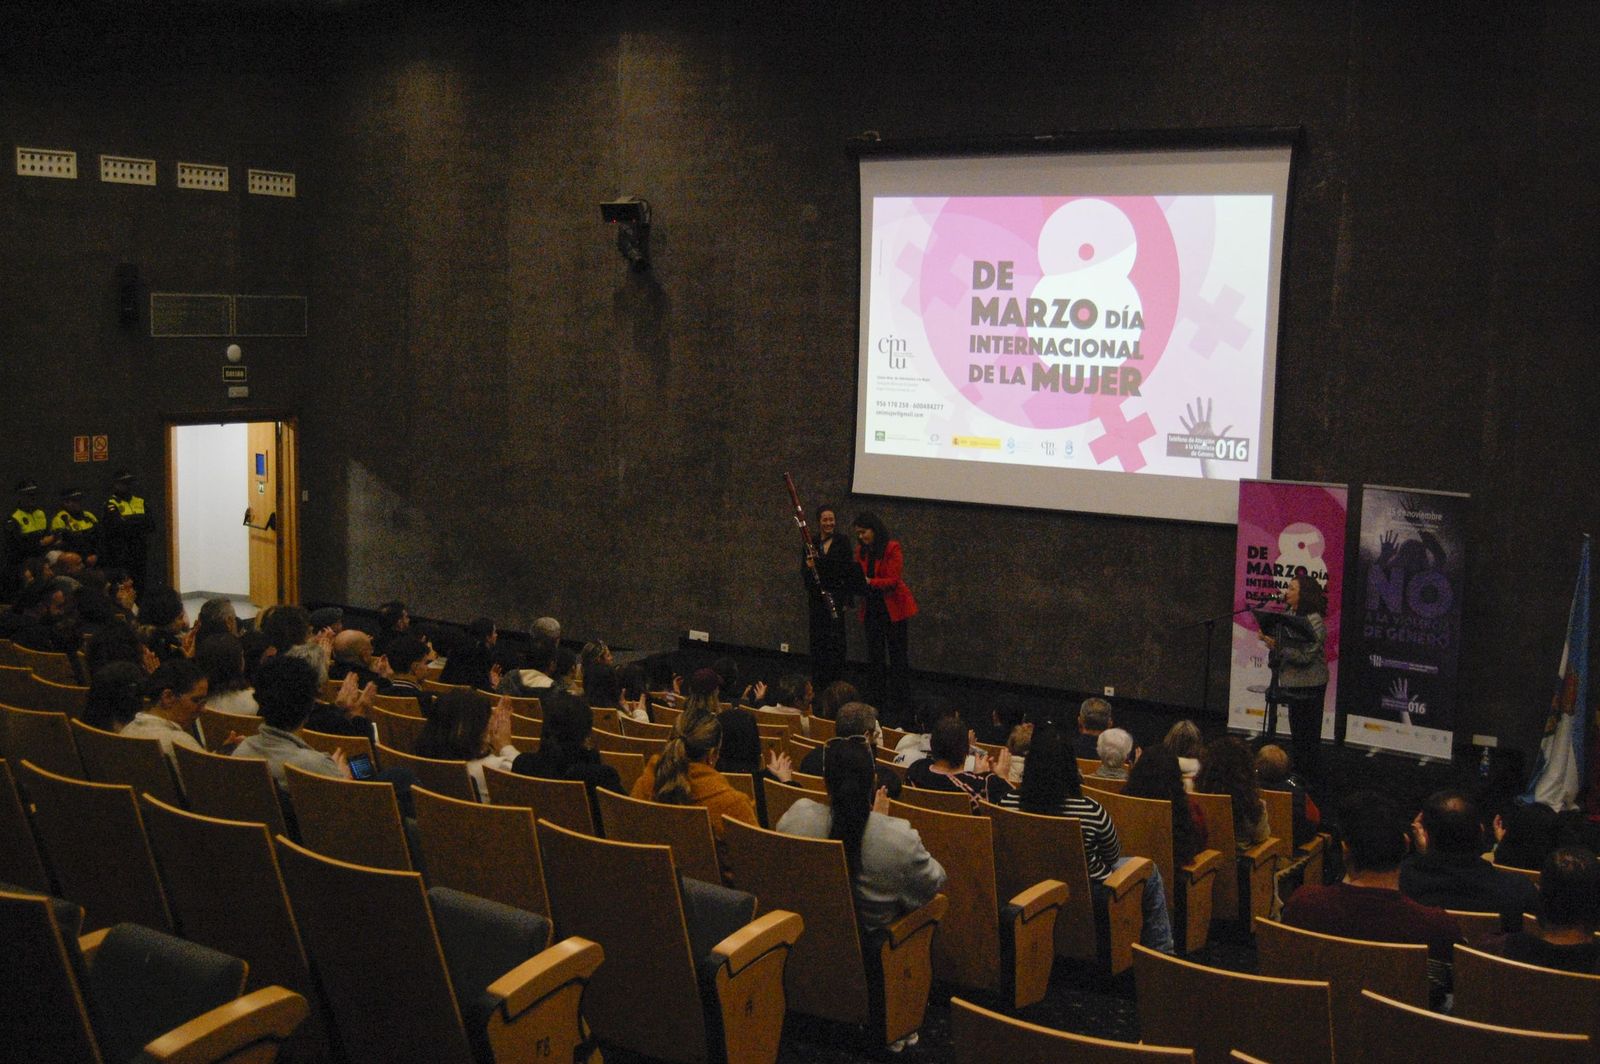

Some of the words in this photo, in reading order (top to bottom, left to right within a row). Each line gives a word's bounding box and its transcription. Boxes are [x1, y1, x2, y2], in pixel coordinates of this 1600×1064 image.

[972, 260, 1014, 291] DE
[970, 296, 1099, 330] MARZO
[1104, 304, 1145, 330] DÍA
[969, 334, 1144, 360] INTERNACIONAL
[968, 364, 994, 384] DE
[1000, 365, 1026, 385] LA
[1031, 362, 1142, 397] MUJER
[1215, 439, 1248, 460] 016
[1405, 509, 1443, 521] noviembre
[1247, 546, 1268, 560] DE
[1246, 561, 1308, 578] MARZO
[1311, 569, 1329, 581] DÍA
[1366, 564, 1454, 618] NO
[1408, 702, 1426, 714] 016
